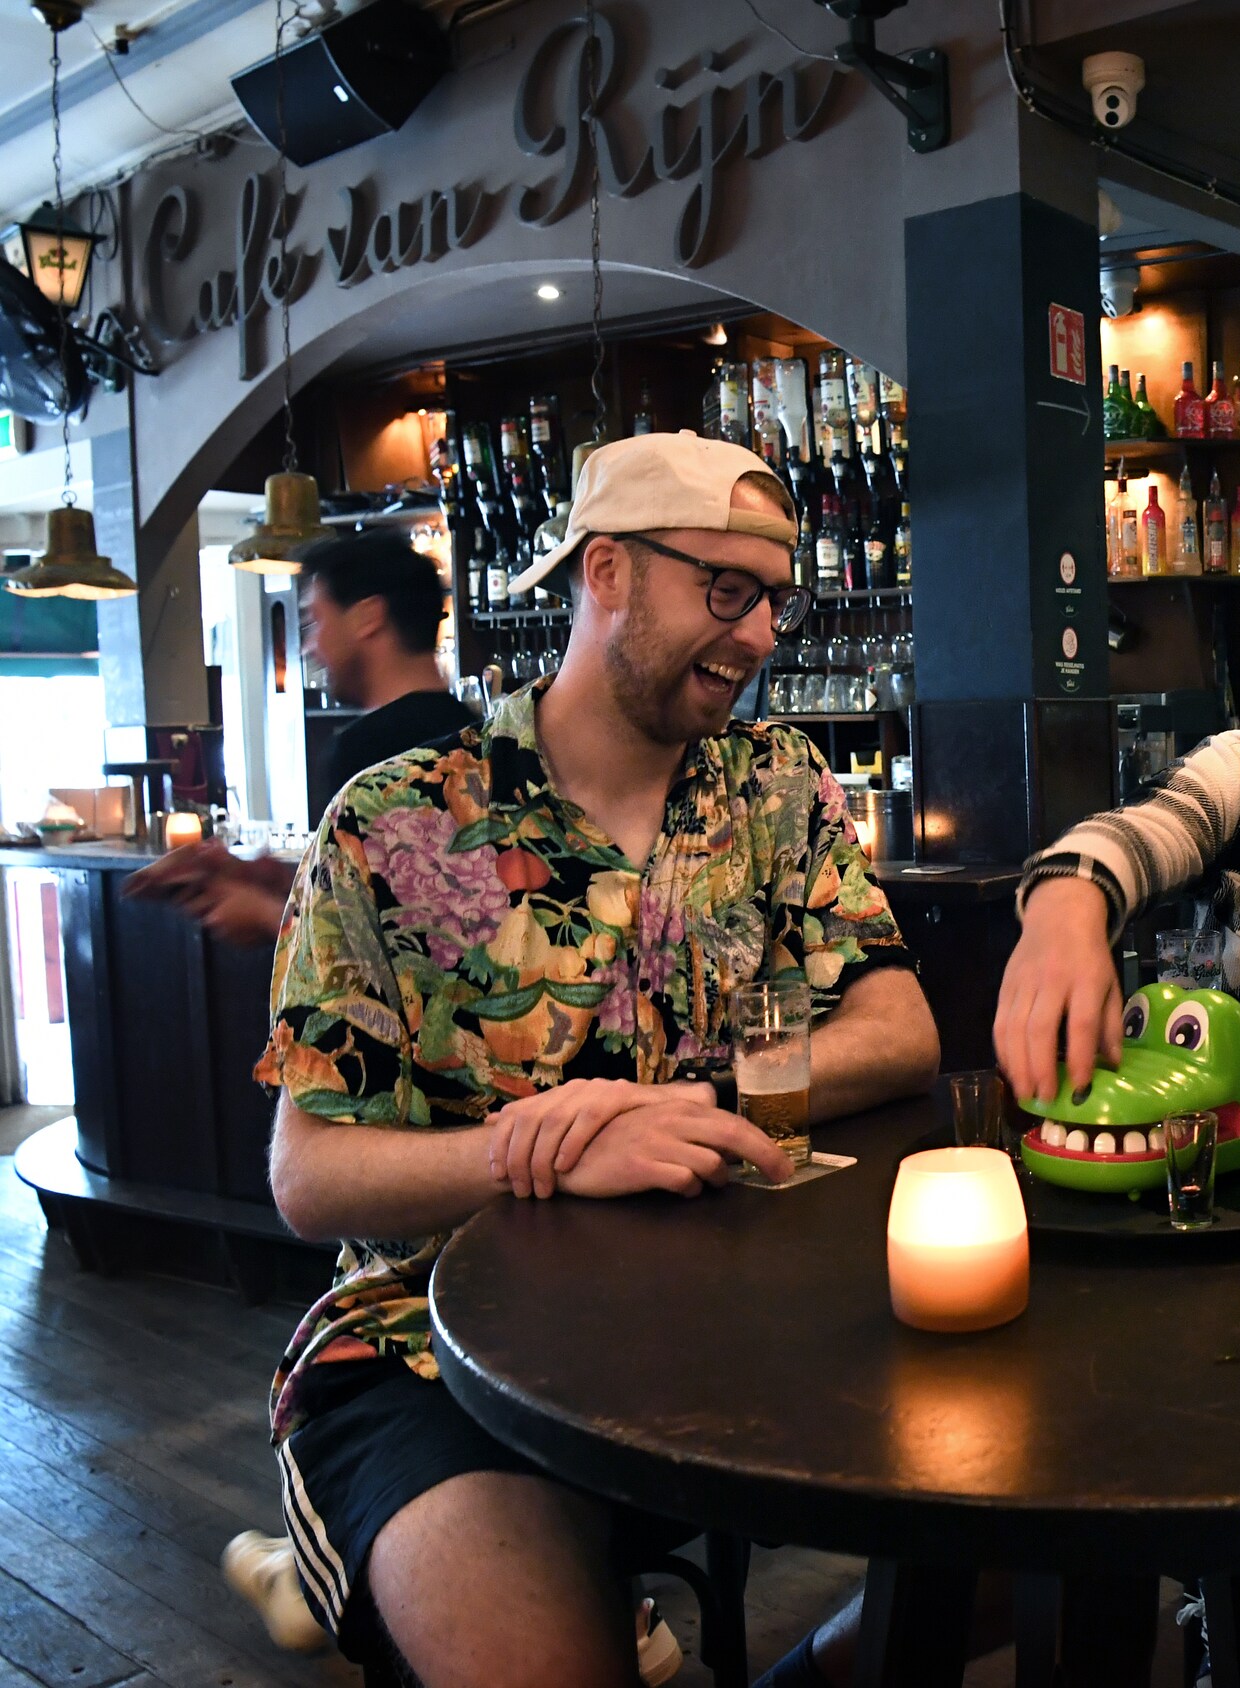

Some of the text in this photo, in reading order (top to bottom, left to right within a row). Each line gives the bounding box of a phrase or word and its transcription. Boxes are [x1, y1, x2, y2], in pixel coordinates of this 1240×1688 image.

[144, 11, 836, 381] Café van Rijn
